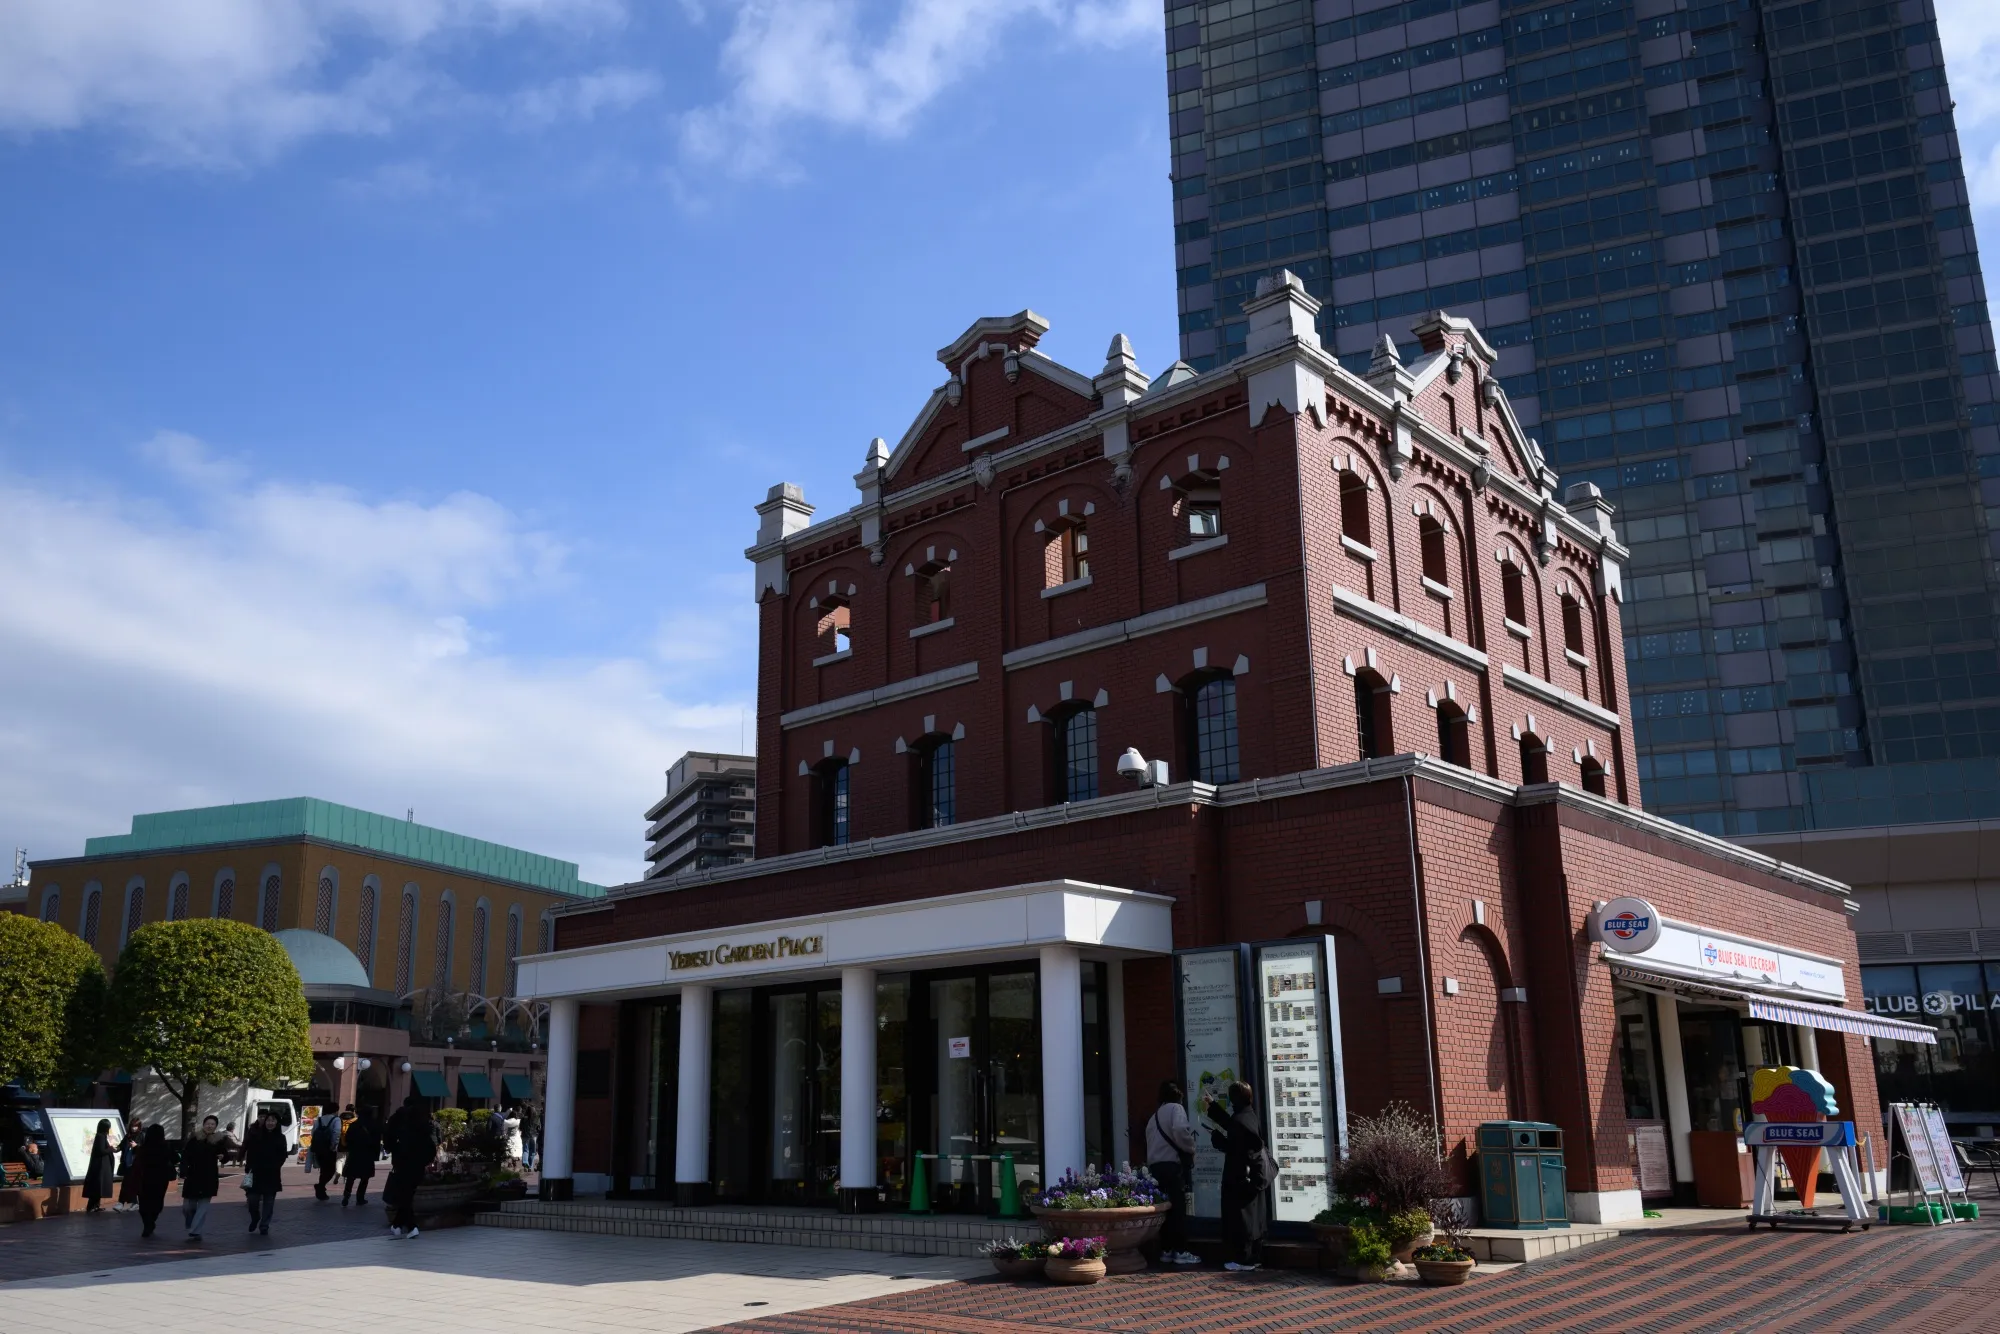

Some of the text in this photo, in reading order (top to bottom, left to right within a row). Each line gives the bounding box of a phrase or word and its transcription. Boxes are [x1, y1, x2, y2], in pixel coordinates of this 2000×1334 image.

[1607, 920, 1647, 929] BLUE SEAL
[668, 936, 823, 970] YEBISU GARDEN PLACE
[1718, 949, 1777, 973] BLUE SEAL ICE CREAM
[1864, 995, 1919, 1013] CLUB
[311, 1036, 341, 1046] AZA
[1769, 1128, 1821, 1138] BLUE SEAL
